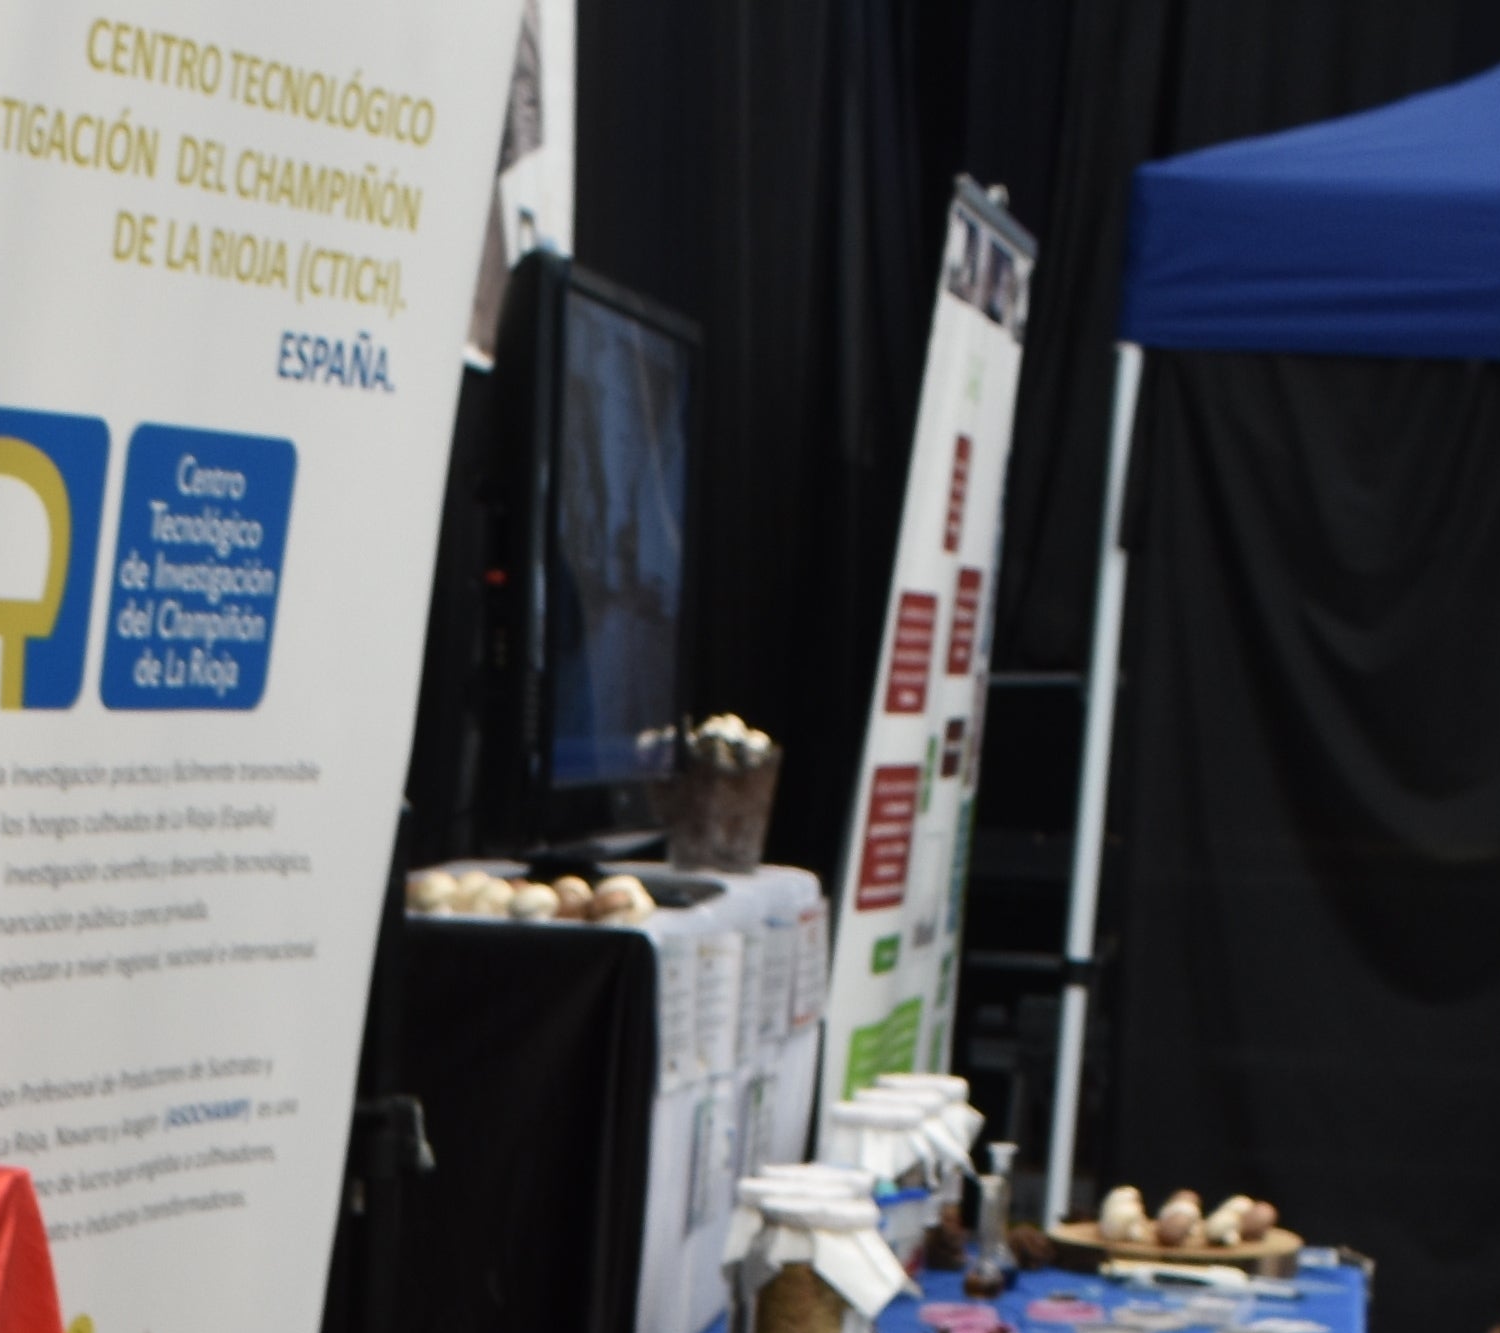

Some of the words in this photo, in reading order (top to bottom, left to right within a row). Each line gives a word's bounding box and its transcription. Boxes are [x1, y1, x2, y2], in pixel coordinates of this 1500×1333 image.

[86, 18, 222, 95] CENTRO
[230, 51, 435, 147] TECNOLÓGICO
[176, 134, 227, 194] DEL
[236, 147, 423, 235] CHAMPIÑÓN
[114, 210, 157, 266] DE
[166, 220, 200, 274] LA
[209, 228, 288, 289] RIOJA
[297, 241, 406, 317] (CTICH).
[276, 330, 396, 393] ESPAÑA.
[177, 455, 246, 499] Centro
[150, 501, 263, 557] Tecnológico
[121, 550, 148, 590] de
[155, 553, 275, 604] Investigación
[119, 600, 153, 639] del
[158, 601, 265, 647] Champiñón
[134, 647, 161, 686] de
[165, 648, 185, 686] La
[190, 649, 239, 696] Rioja
